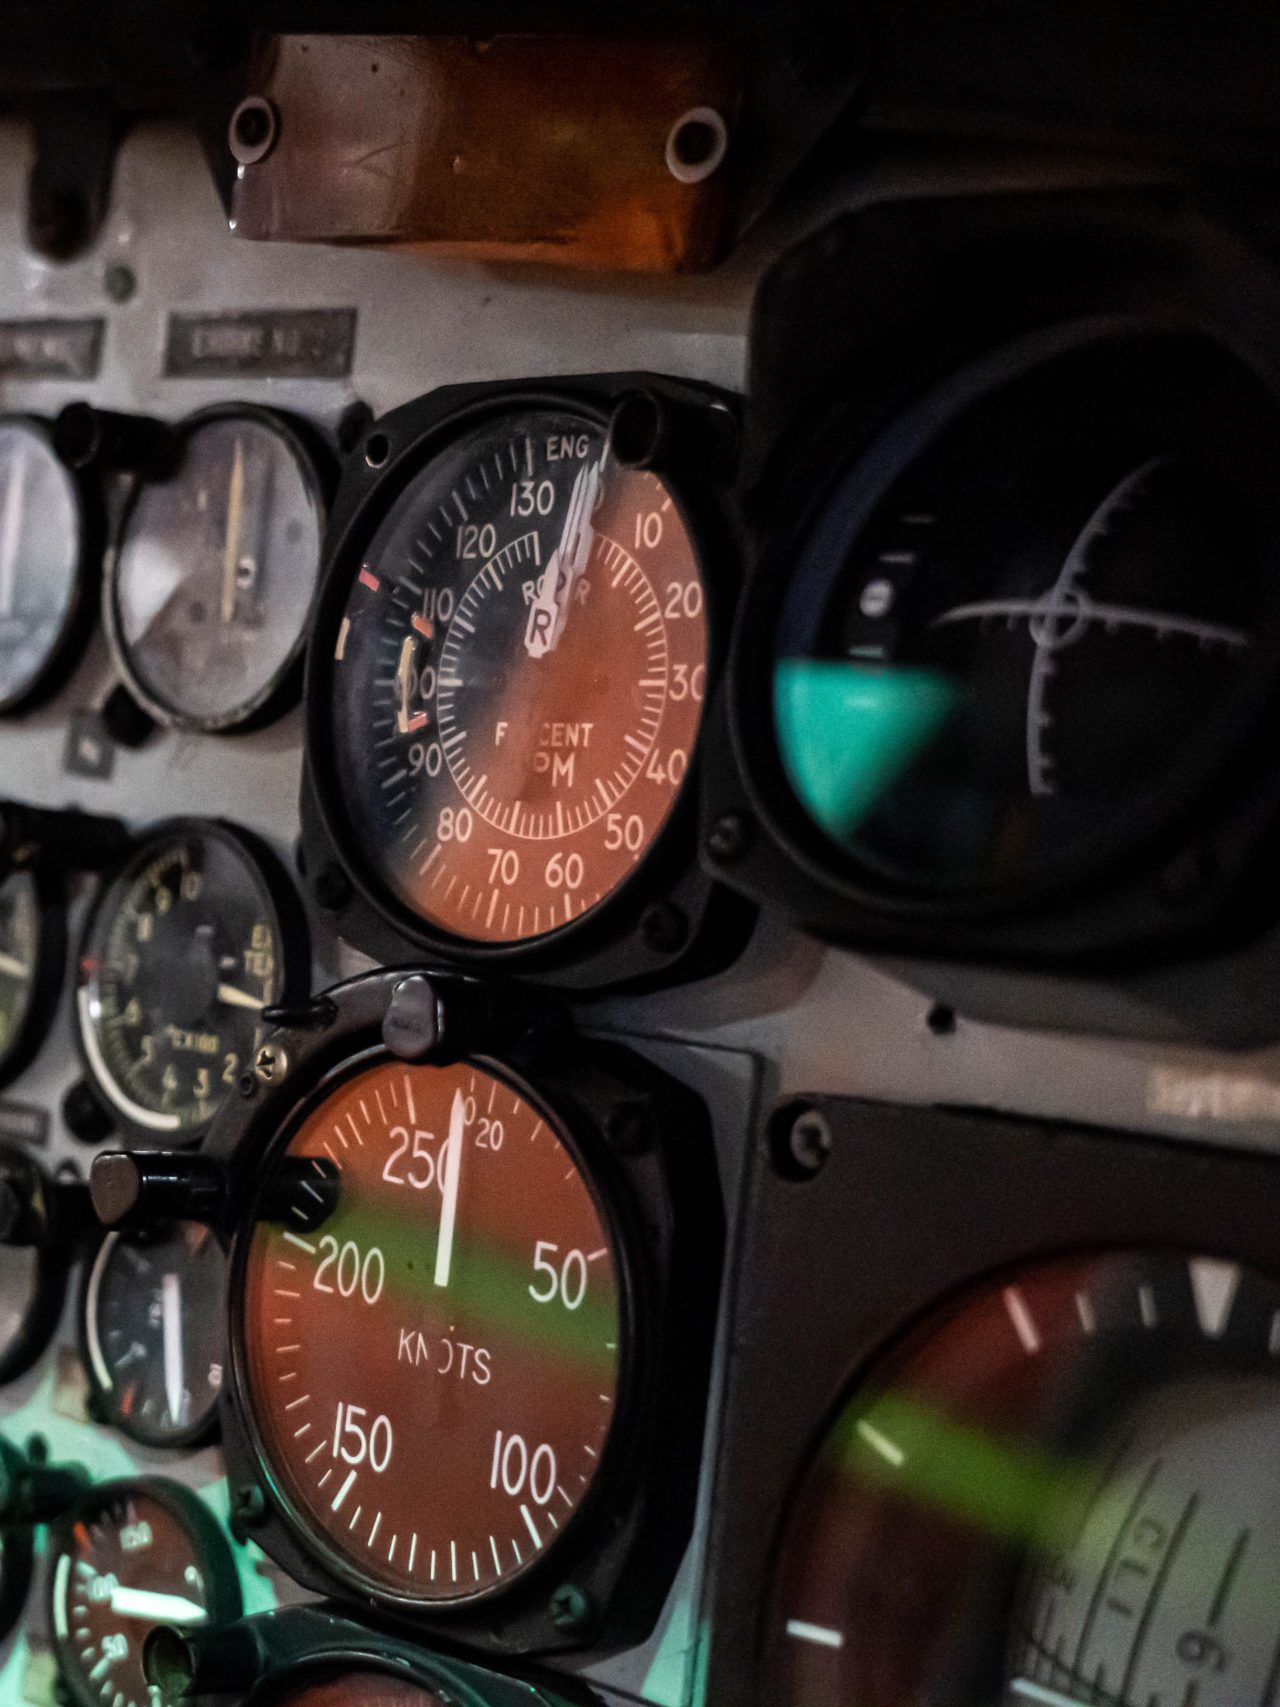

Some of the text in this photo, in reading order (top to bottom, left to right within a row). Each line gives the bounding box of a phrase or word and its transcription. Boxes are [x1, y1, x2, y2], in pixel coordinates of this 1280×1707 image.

[546, 434, 589, 461] ENG
[510, 480, 555, 516] 130
[456, 523, 496, 560] 120
[635, 512, 663, 549] 10
[423, 587, 454, 622] 110
[665, 580, 703, 618] 20
[530, 607, 552, 647] R
[408, 742, 442, 777] 90
[646, 748, 686, 785] 40
[436, 806, 471, 843] 80
[604, 813, 644, 851] 50
[487, 848, 519, 885] 70
[545, 852, 583, 889] 60
[222, 1053, 239, 1083] 2
[474, 1116, 504, 1151] 20
[313, 1235, 385, 1304] 200
[528, 1240, 588, 1310] 50
[332, 1401, 393, 1472] 150
[490, 1430, 557, 1505] 100
